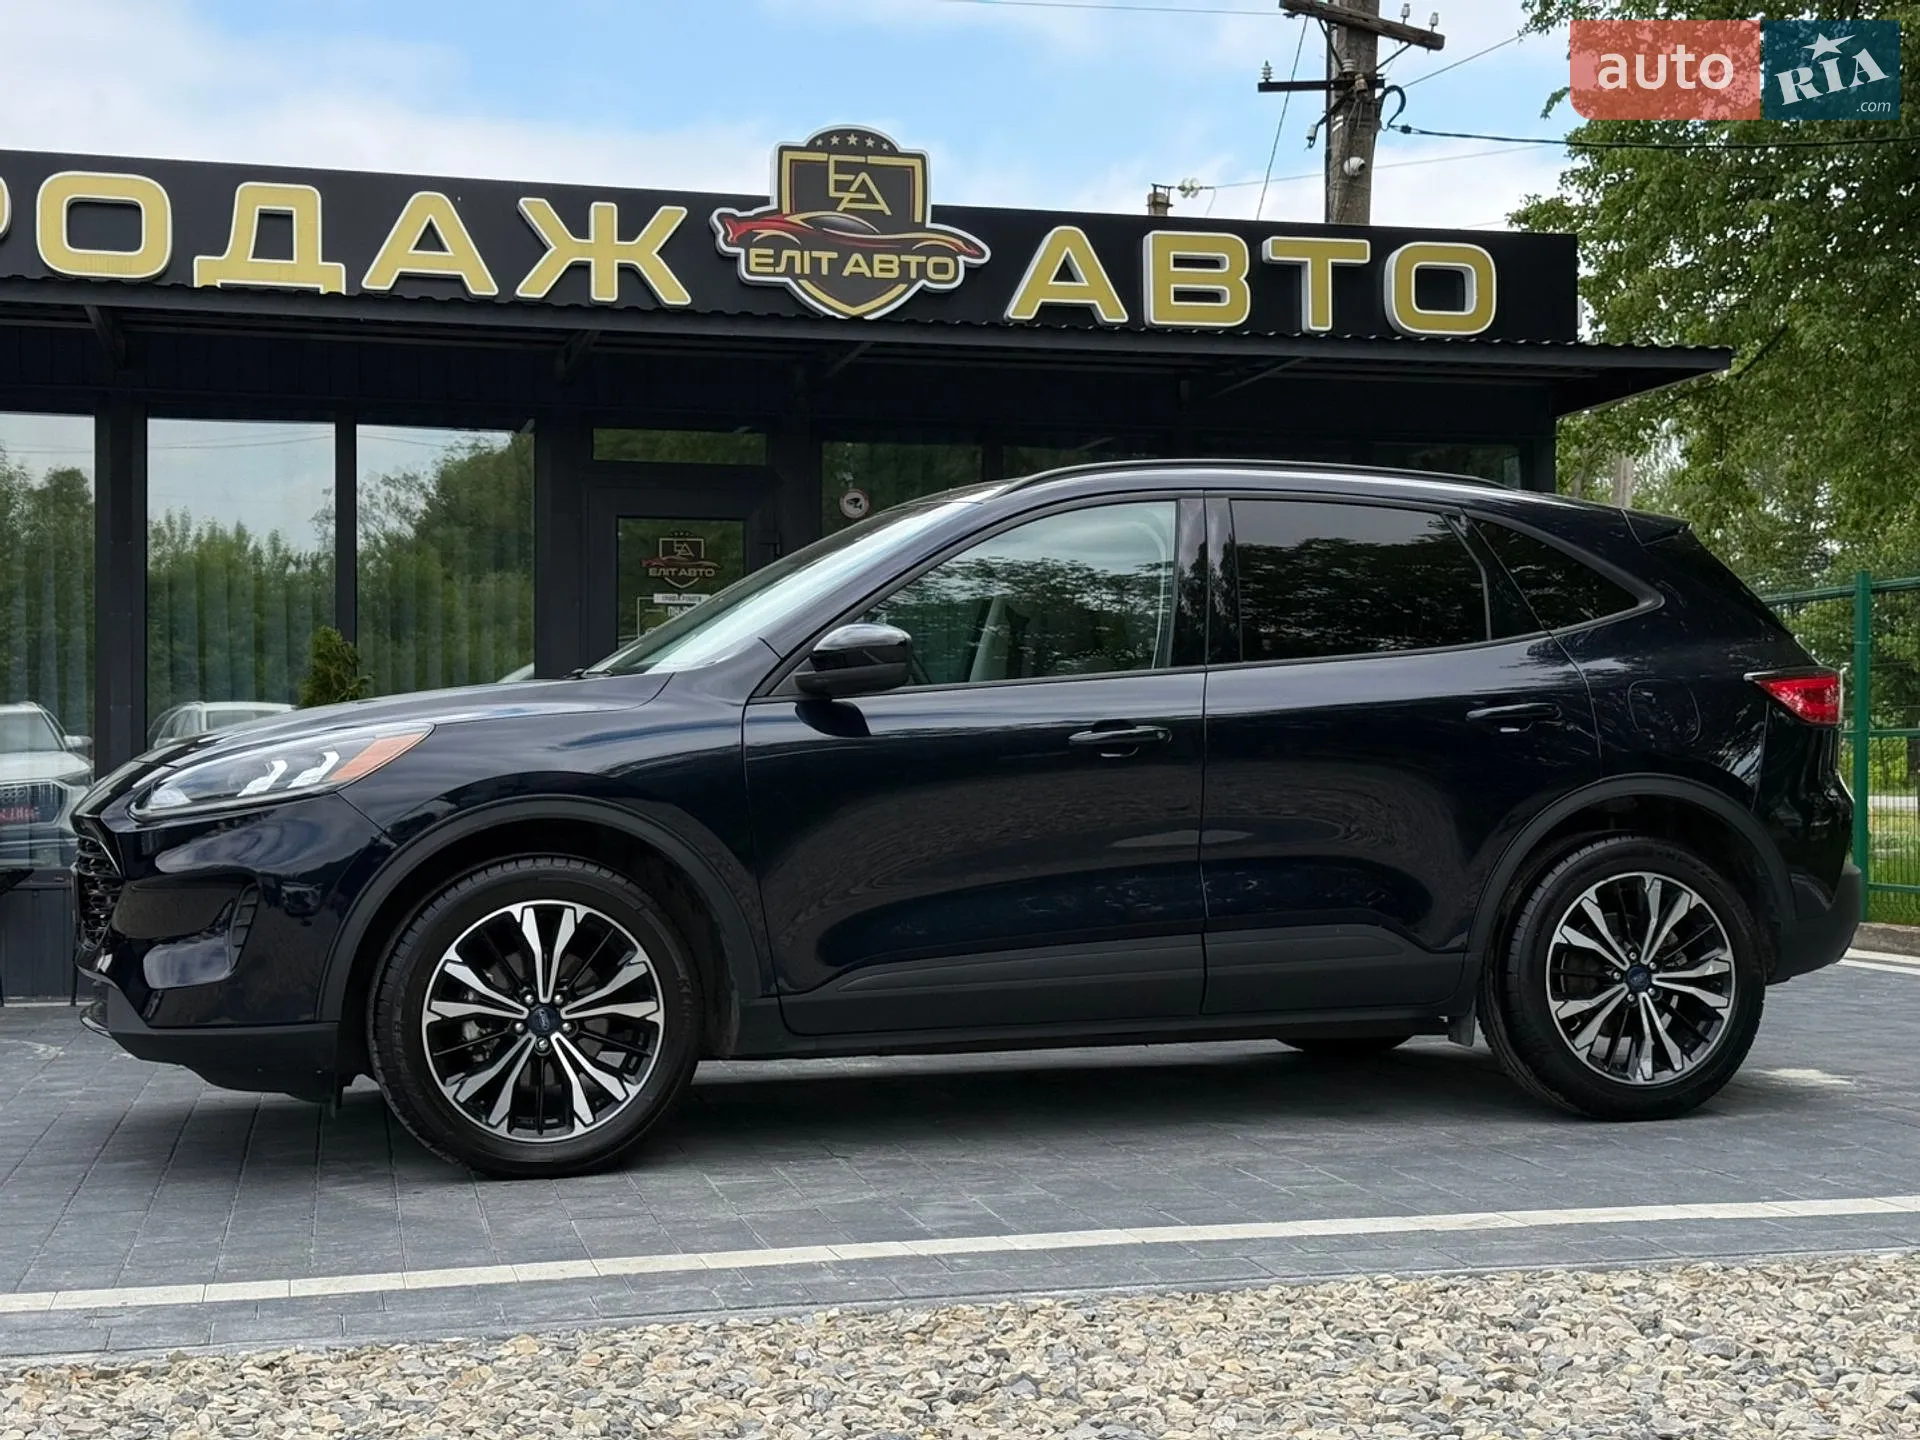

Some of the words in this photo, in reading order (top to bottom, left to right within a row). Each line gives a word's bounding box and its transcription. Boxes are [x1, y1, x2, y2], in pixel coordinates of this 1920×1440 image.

[0, 170, 693, 307] ОДАЖ
[748, 247, 839, 276] ЕЛІТ
[841, 252, 956, 281] АВТО
[1004, 225, 1497, 337] АВТО
[677, 567, 716, 578] АВТО
